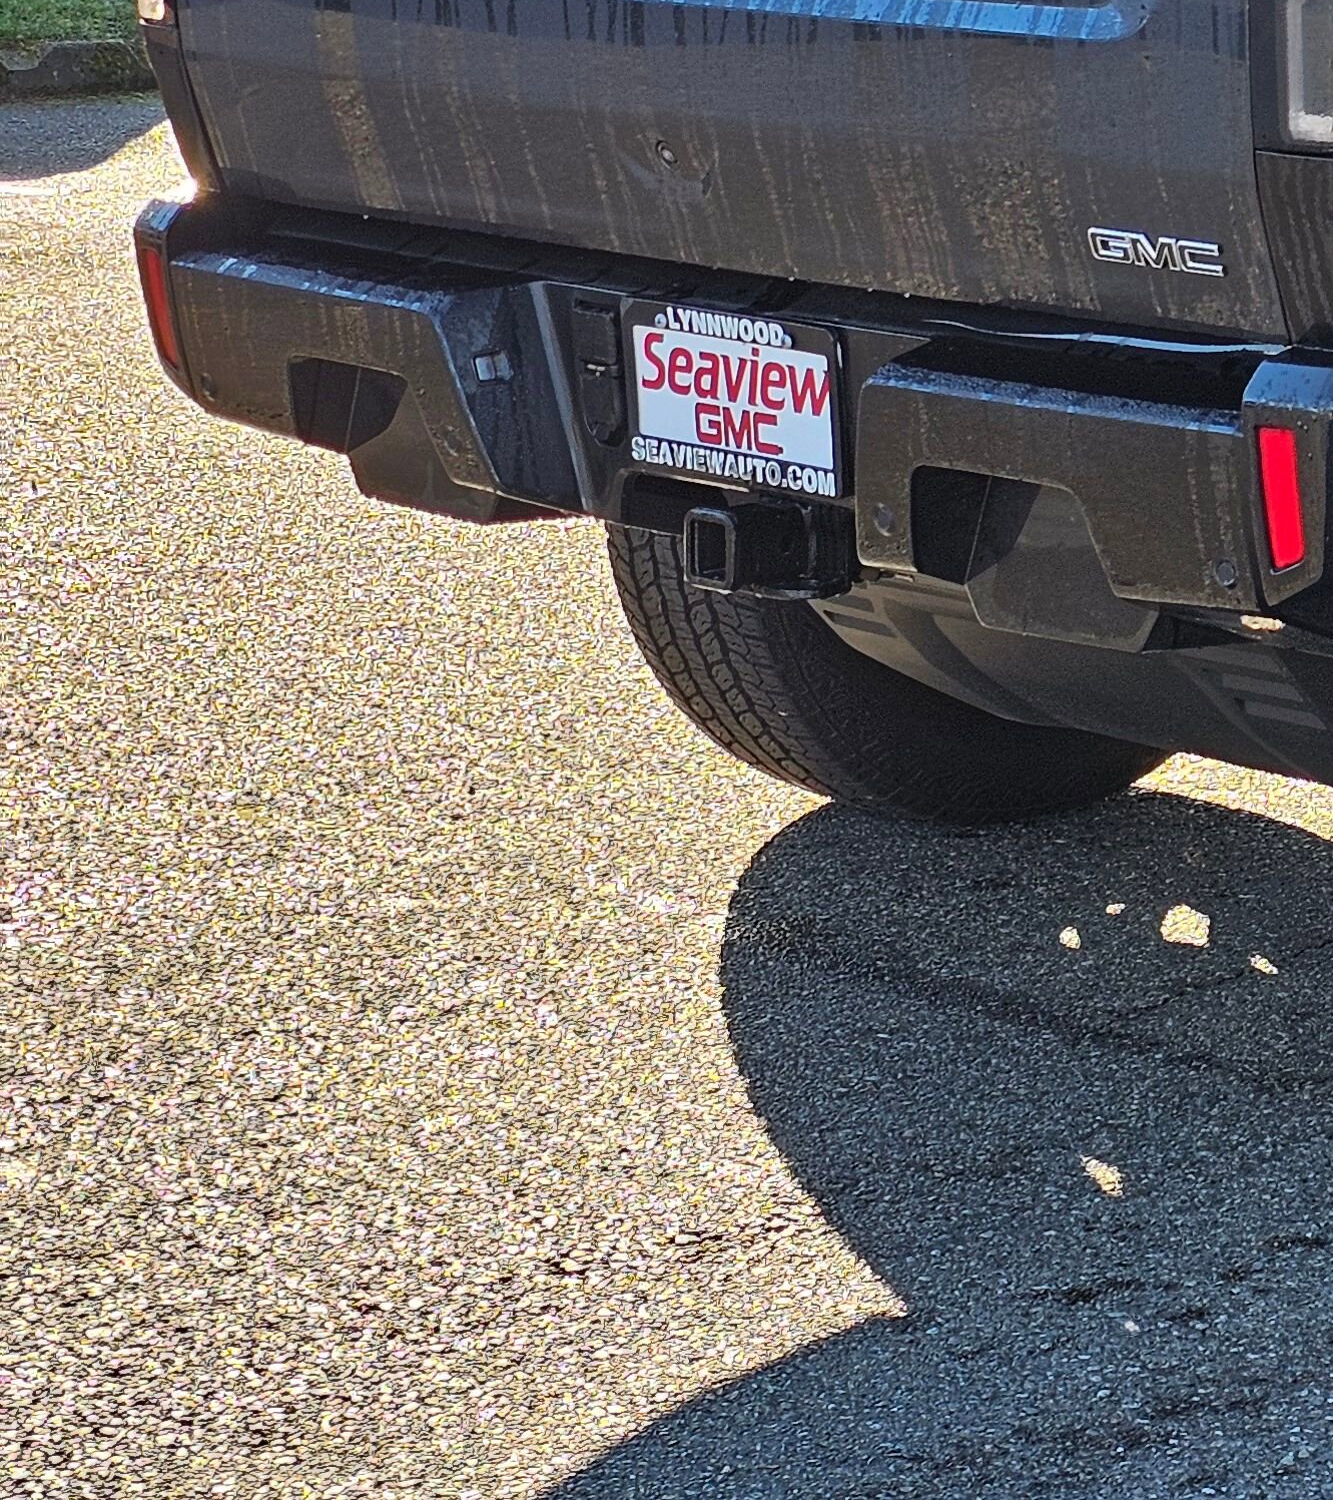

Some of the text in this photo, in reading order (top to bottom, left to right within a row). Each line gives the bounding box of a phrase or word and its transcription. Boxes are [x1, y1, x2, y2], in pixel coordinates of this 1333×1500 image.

[1087, 227, 1225, 277] GMC
[666, 306, 785, 348] LYNNWOOD
[641, 332, 832, 417] Seaview
[694, 402, 784, 456] GMC
[631, 436, 836, 497] SEAVIEWAUTO.COM
